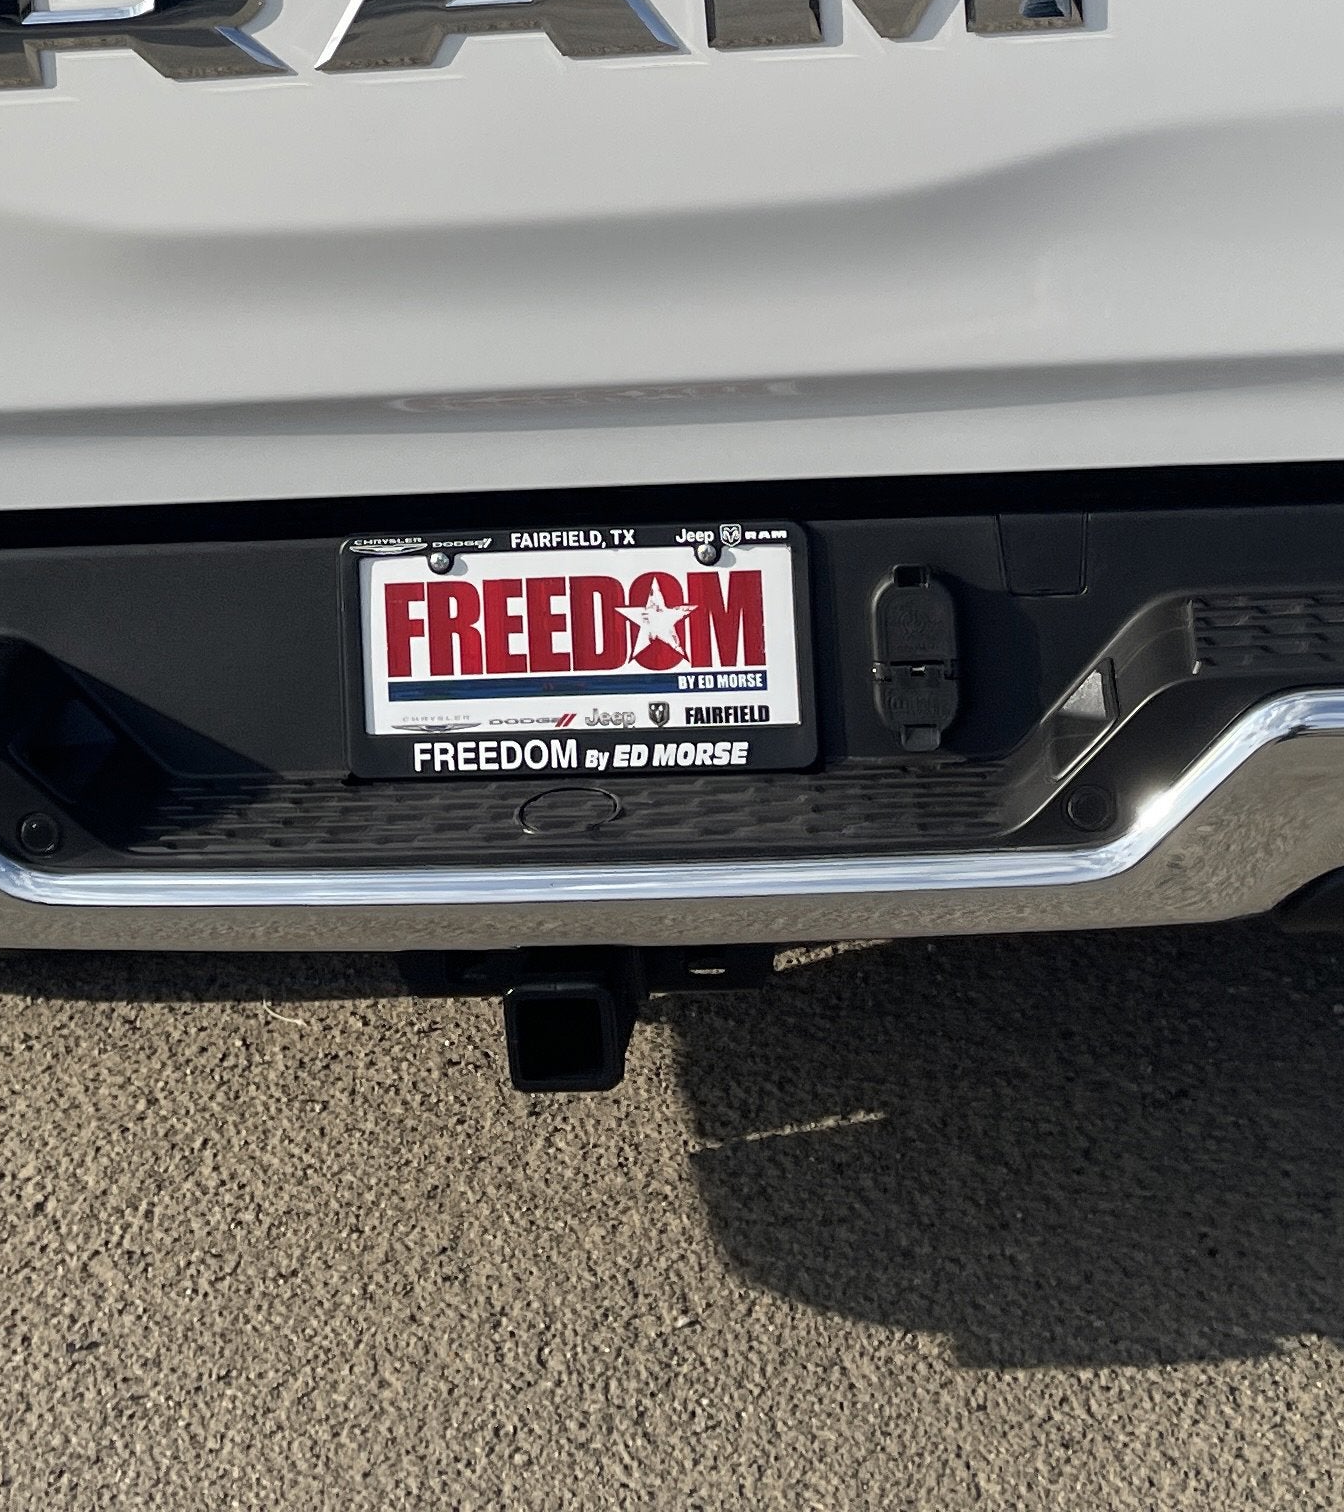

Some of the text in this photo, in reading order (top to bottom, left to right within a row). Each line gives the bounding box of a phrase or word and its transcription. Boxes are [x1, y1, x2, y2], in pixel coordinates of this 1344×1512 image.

[510, 531, 607, 549] FAIRFIELD,
[609, 529, 636, 545] TX
[675, 528, 715, 544] Jeep
[744, 530, 788, 539] RAM
[384, 569, 767, 677] FREEDOM
[677, 672, 764, 690] BY ED MORSE
[584, 708, 638, 729] Jeep
[684, 704, 771, 725] FAIRFIELD
[413, 738, 750, 772] FREEDOM By ED MORSE
